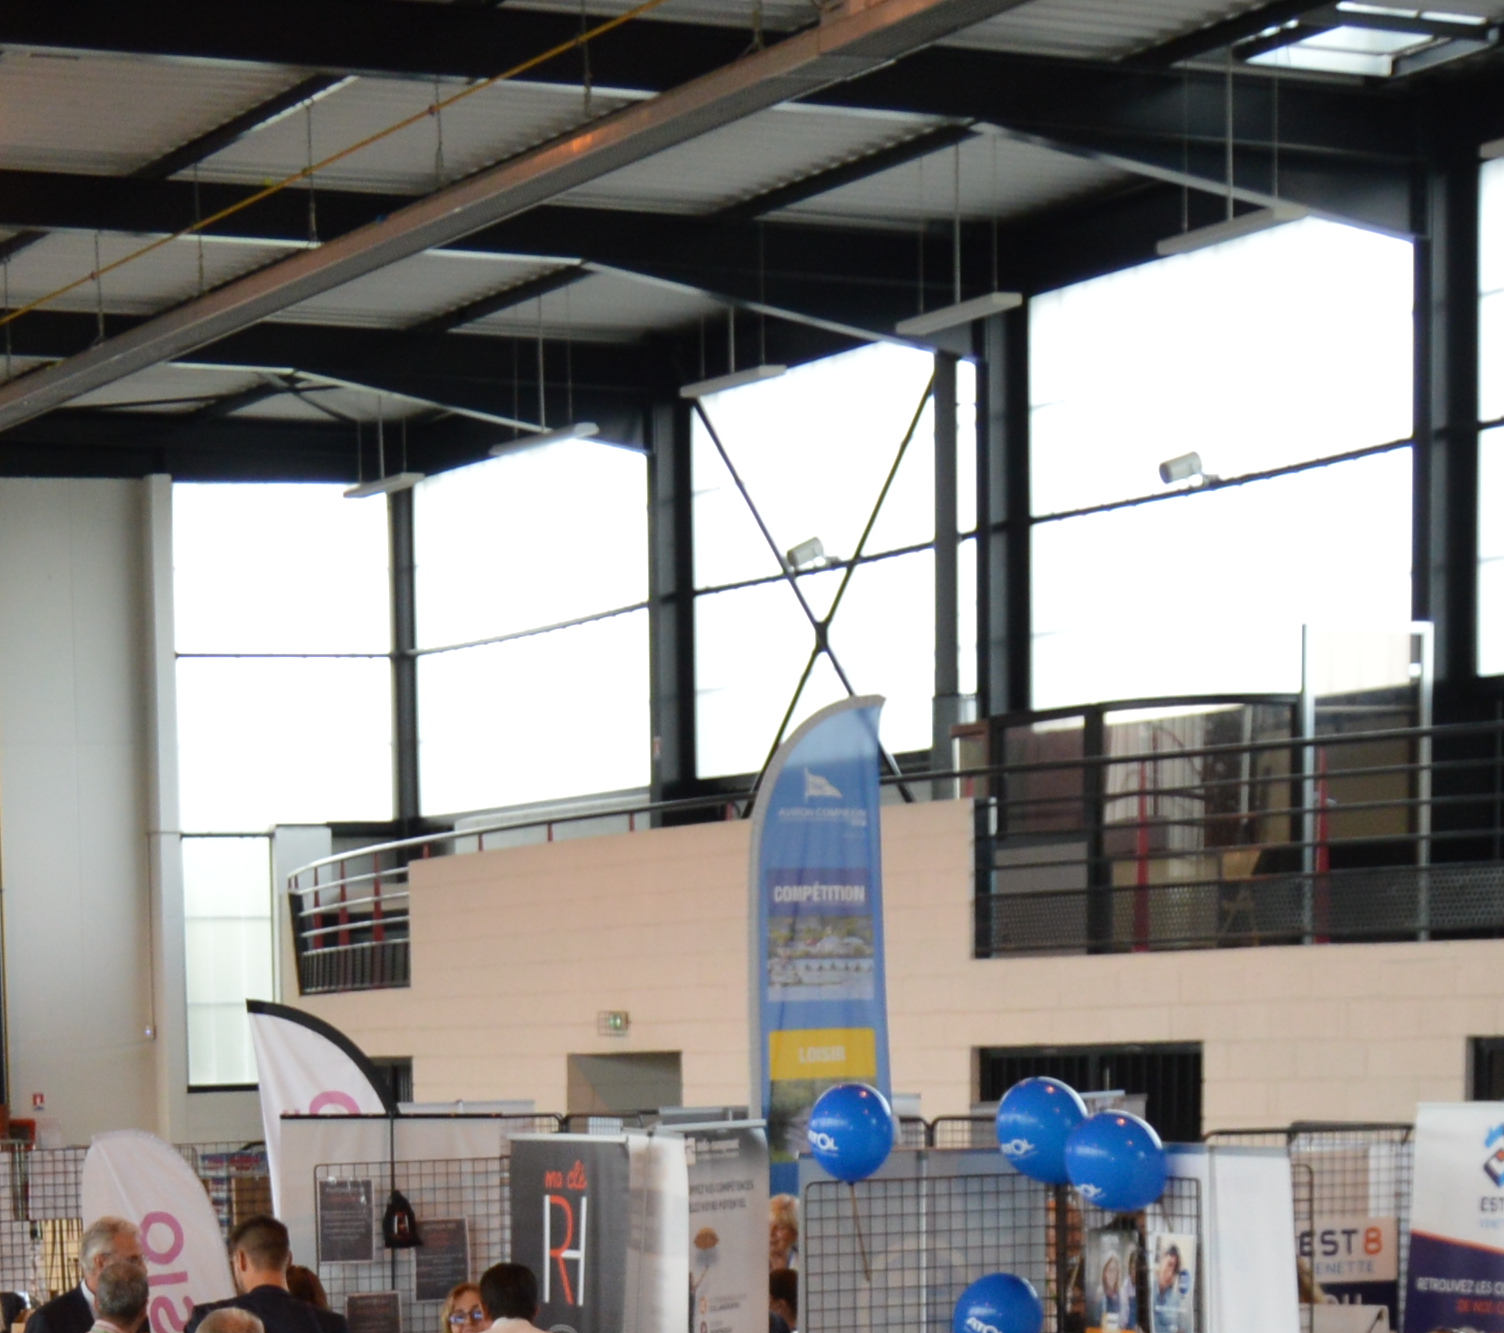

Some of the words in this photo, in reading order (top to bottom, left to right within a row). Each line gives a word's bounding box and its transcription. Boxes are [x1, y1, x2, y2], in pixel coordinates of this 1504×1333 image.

[774, 881, 865, 903] COMPÉTITION
[799, 1045, 846, 1063] LOISIR
[1313, 1260, 1375, 1275] ENETTE
[1416, 1277, 1474, 1294] RETROUVEZ
[1476, 1280, 1492, 1295] LES
